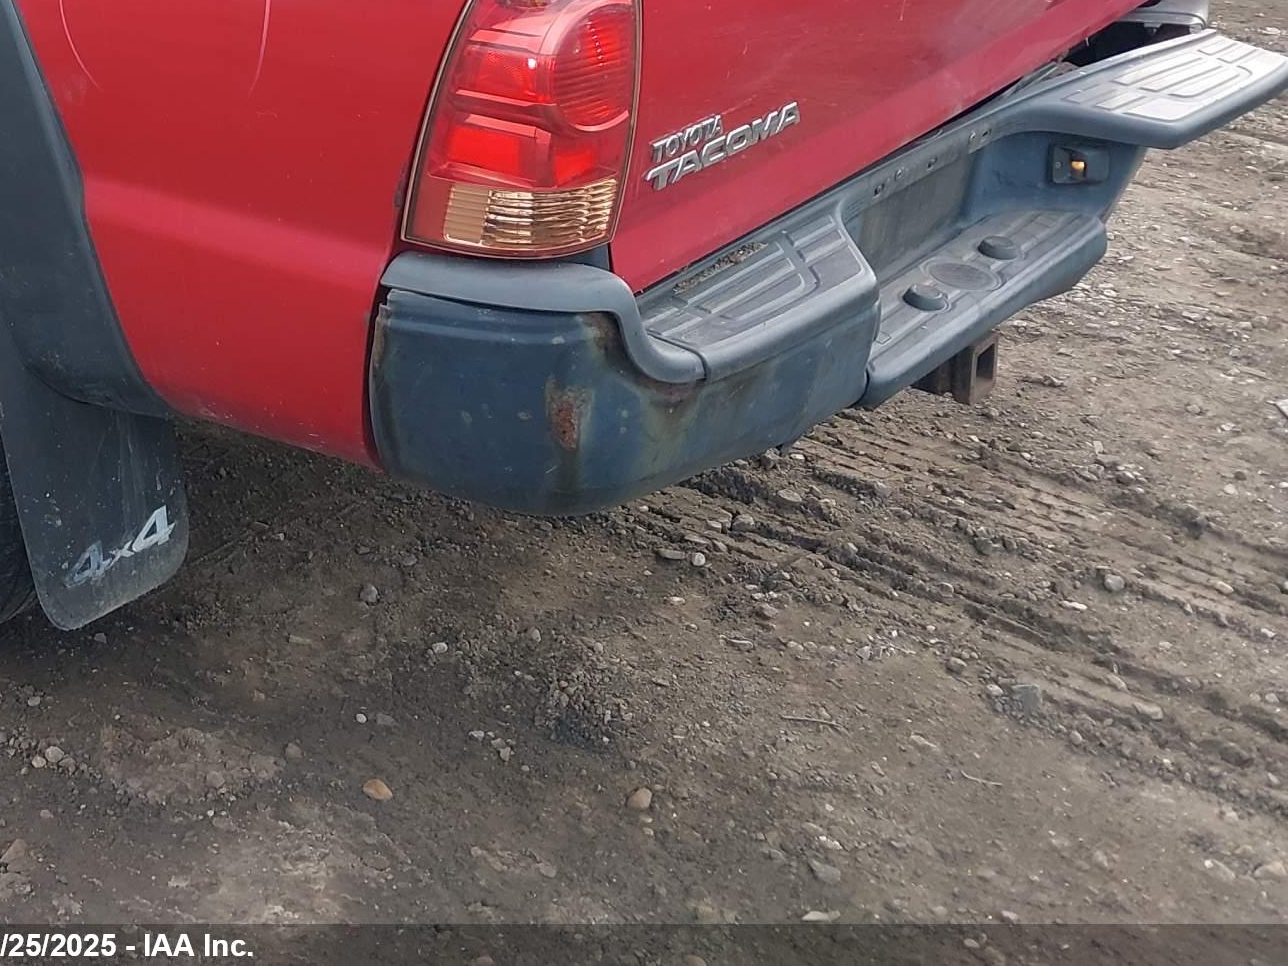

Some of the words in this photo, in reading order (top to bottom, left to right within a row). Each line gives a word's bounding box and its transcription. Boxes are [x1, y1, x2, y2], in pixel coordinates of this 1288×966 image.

[644, 100, 801, 192] TACOMA
[650, 113, 724, 163] TOYOTA
[65, 504, 176, 588] 4x4
